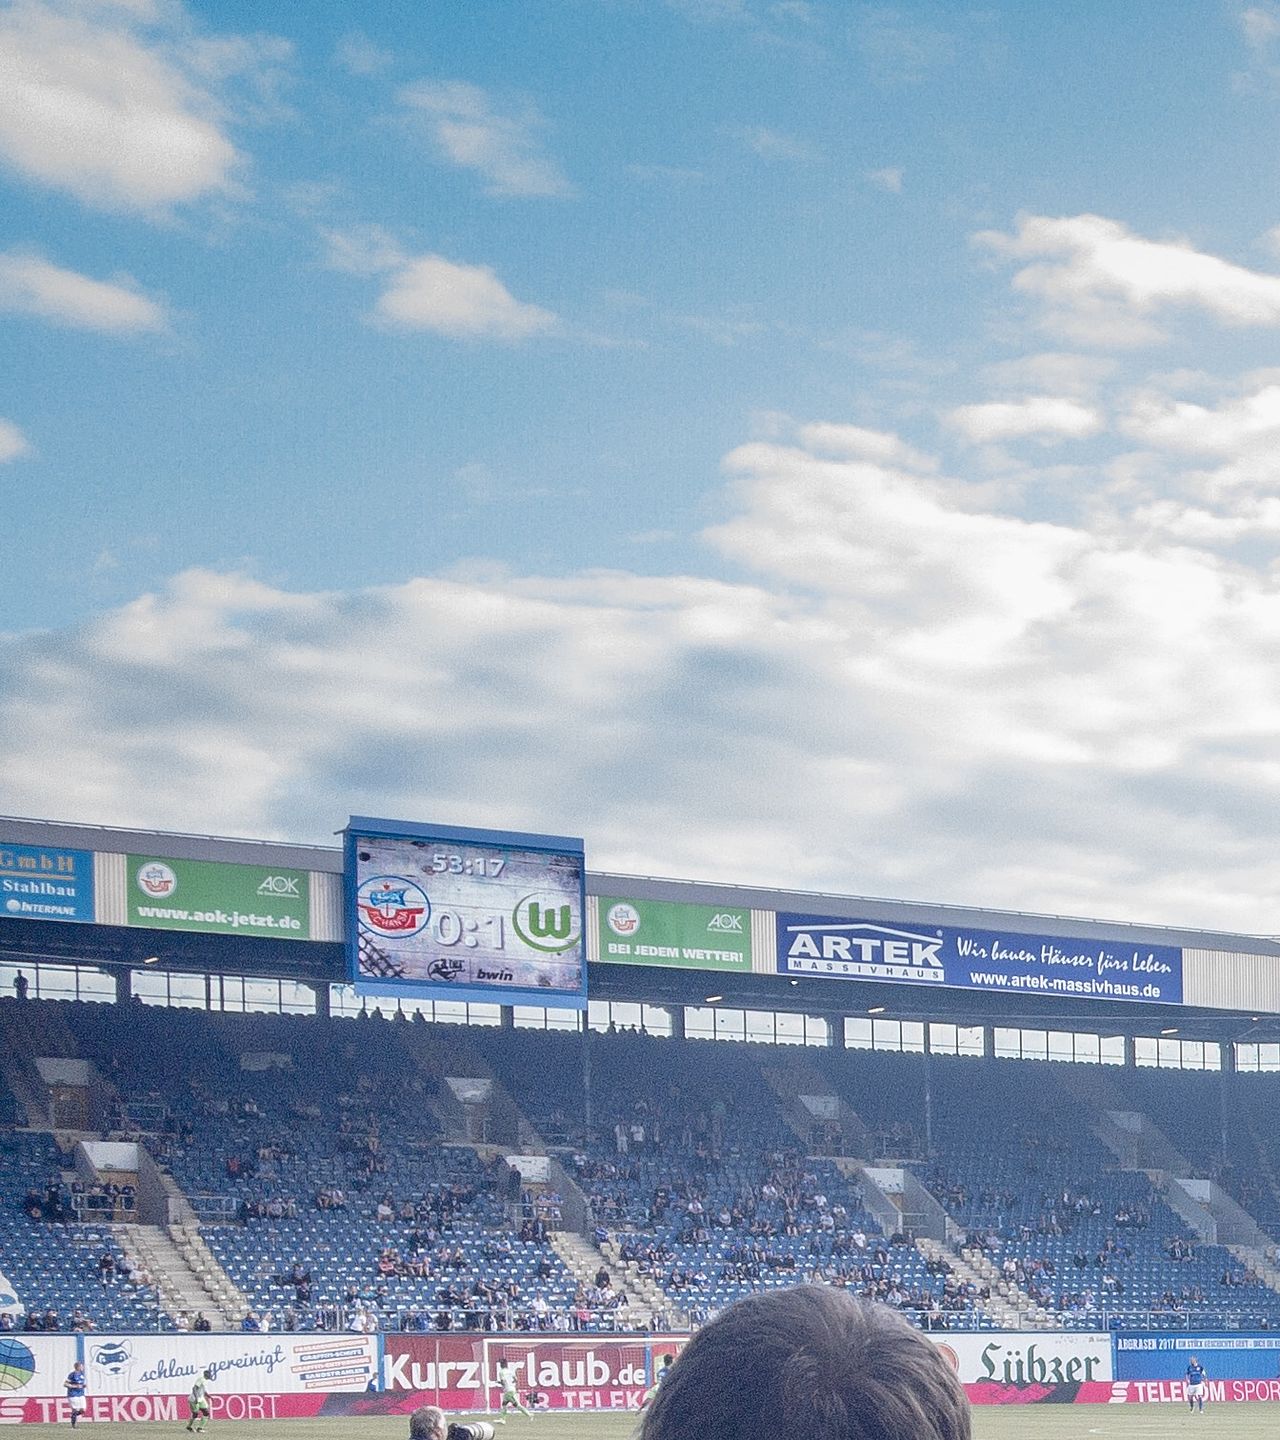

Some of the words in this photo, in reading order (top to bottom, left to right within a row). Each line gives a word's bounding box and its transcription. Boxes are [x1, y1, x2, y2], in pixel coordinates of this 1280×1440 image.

[432, 853, 505, 877] 53:17
[3, 879, 76, 897] Stahlbau
[258, 876, 300, 894] AOK
[138, 905, 301, 930] www.aok-jetzt.de
[432, 909, 504, 950] 0:1
[708, 913, 743, 931] AOK
[608, 943, 631, 955] BEI
[634, 945, 679, 958] JEDEM
[682, 948, 744, 963] WETTER!
[788, 934, 944, 967] ARTEK
[957, 937, 988, 958] Wir
[991, 941, 1036, 961] bauen
[1041, 945, 1094, 967] Häuser
[1097, 951, 1128, 975] fürs
[1132, 952, 1172, 973] Leben
[477, 968, 513, 982] bwin
[793, 961, 941, 979] MASSIVHAUS
[970, 972, 1161, 998] www.artek-massivhaus.de
[1159, 1339, 1175, 1350] 2017
[383, 1351, 645, 1390] Kurzurlaub.de
[975, 1342, 1101, 1384] Lübzer
[207, 1394, 281, 1420] PORT
[562, 1390, 648, 1409] TELEK
